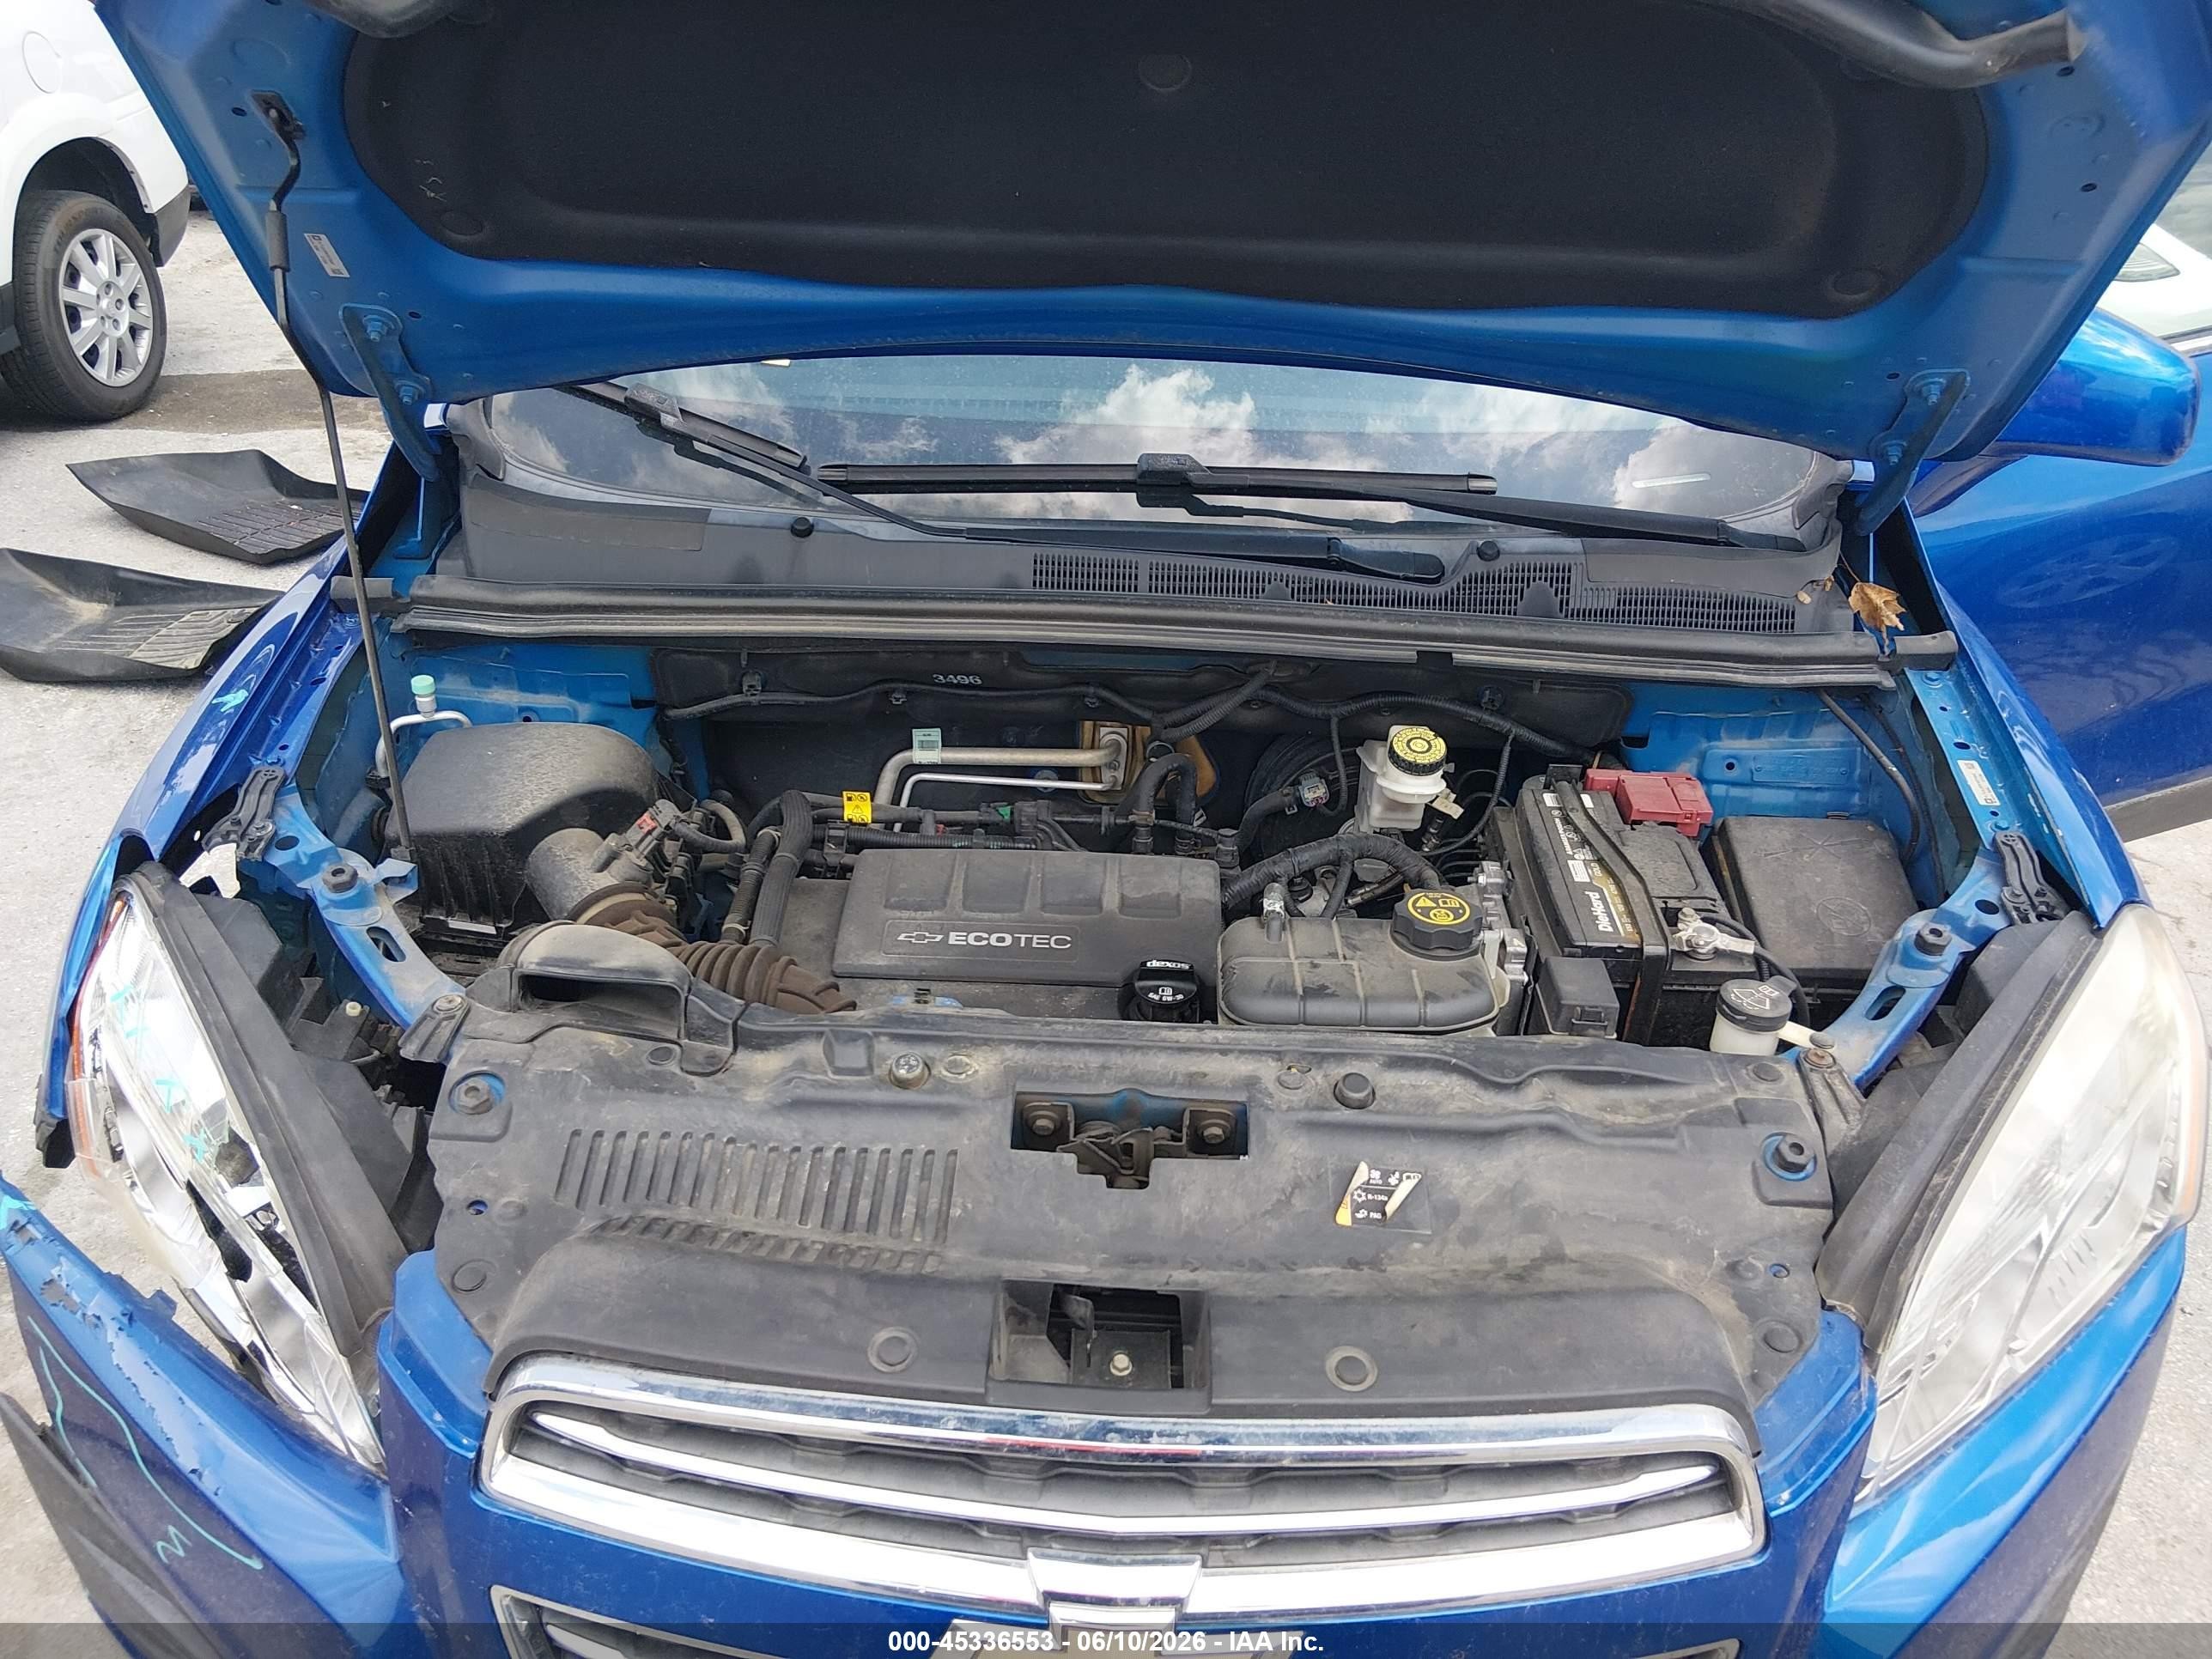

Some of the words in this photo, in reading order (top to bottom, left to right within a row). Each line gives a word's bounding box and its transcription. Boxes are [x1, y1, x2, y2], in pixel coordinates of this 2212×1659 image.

[933, 673, 982, 685] 3496
[1584, 890, 1614, 933] DieHard
[948, 932, 1073, 949] ECOTEC
[1146, 959, 1189, 969] dexos
